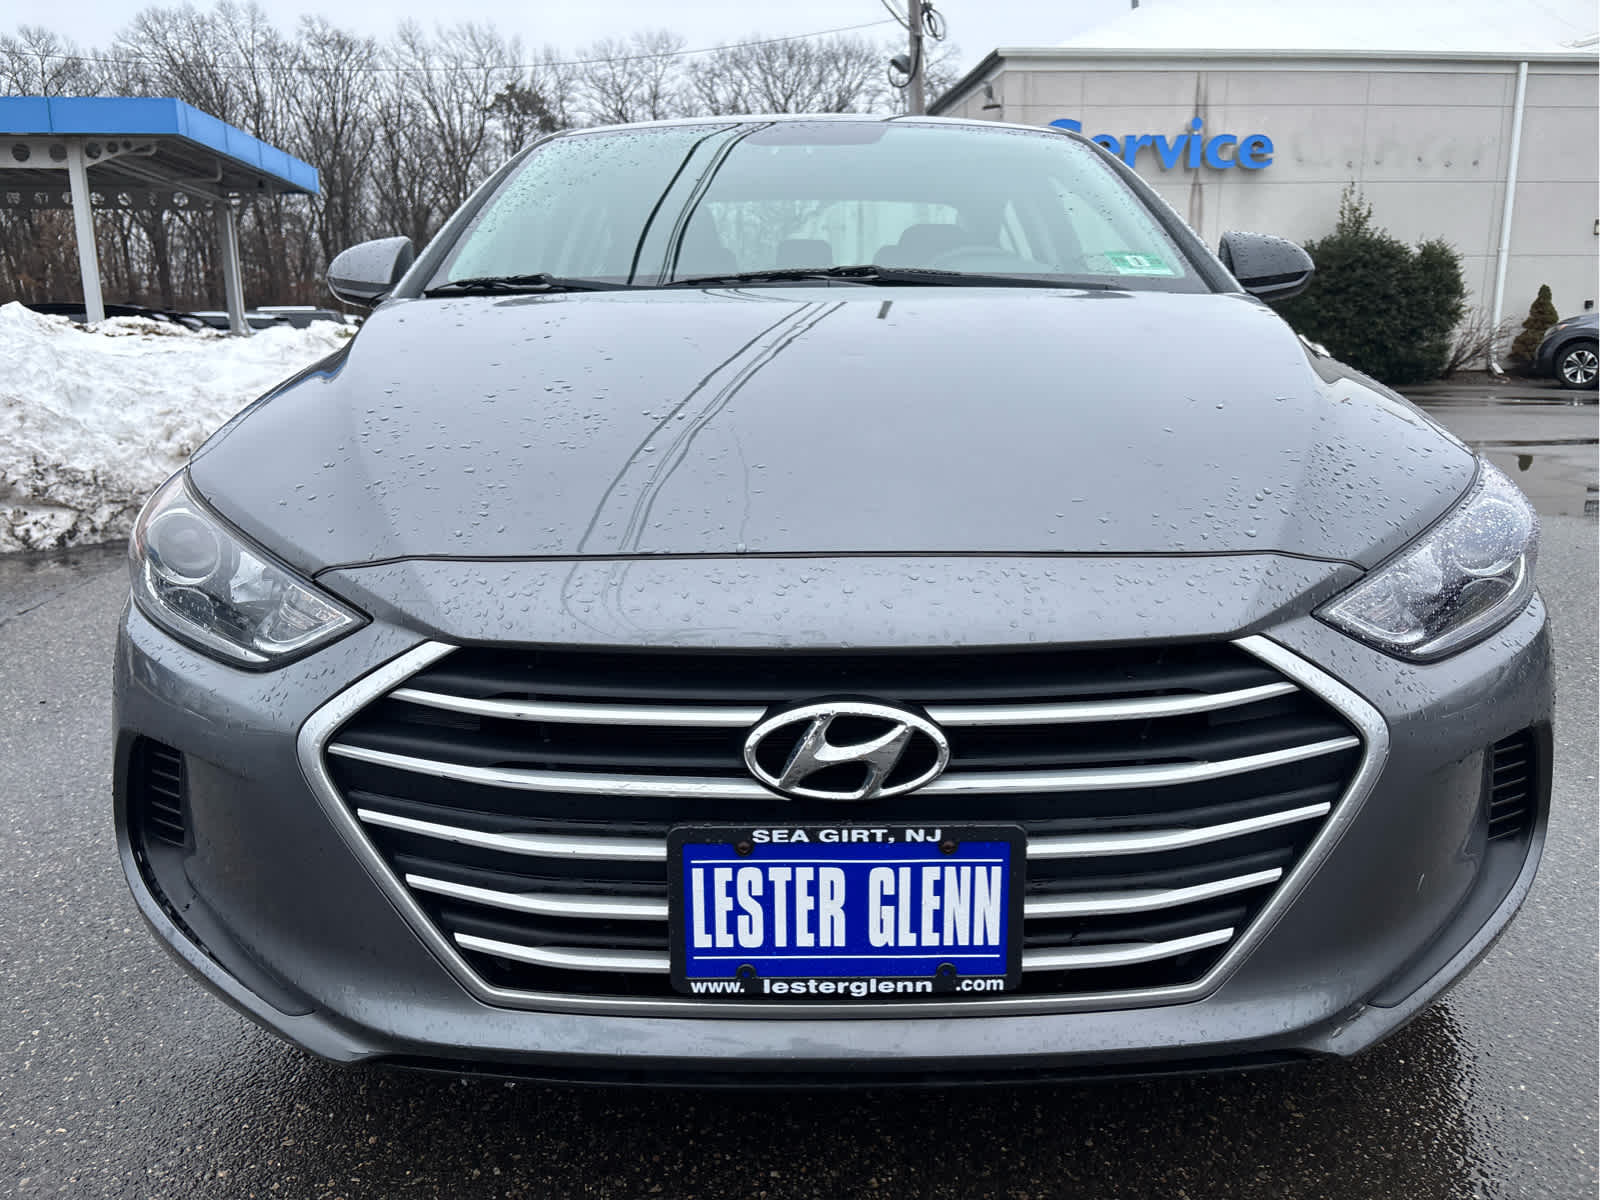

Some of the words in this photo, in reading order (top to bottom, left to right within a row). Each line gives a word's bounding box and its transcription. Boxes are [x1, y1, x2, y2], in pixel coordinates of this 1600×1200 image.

[752, 829, 809, 843] SEA
[818, 829, 895, 844] GIRT,
[905, 828, 942, 842] NJ
[691, 867, 846, 948] LESTER
[868, 866, 1002, 947] GLENN
[690, 981, 745, 993] www.
[763, 978, 933, 997] lesterglenn
[955, 979, 1004, 991] .com
